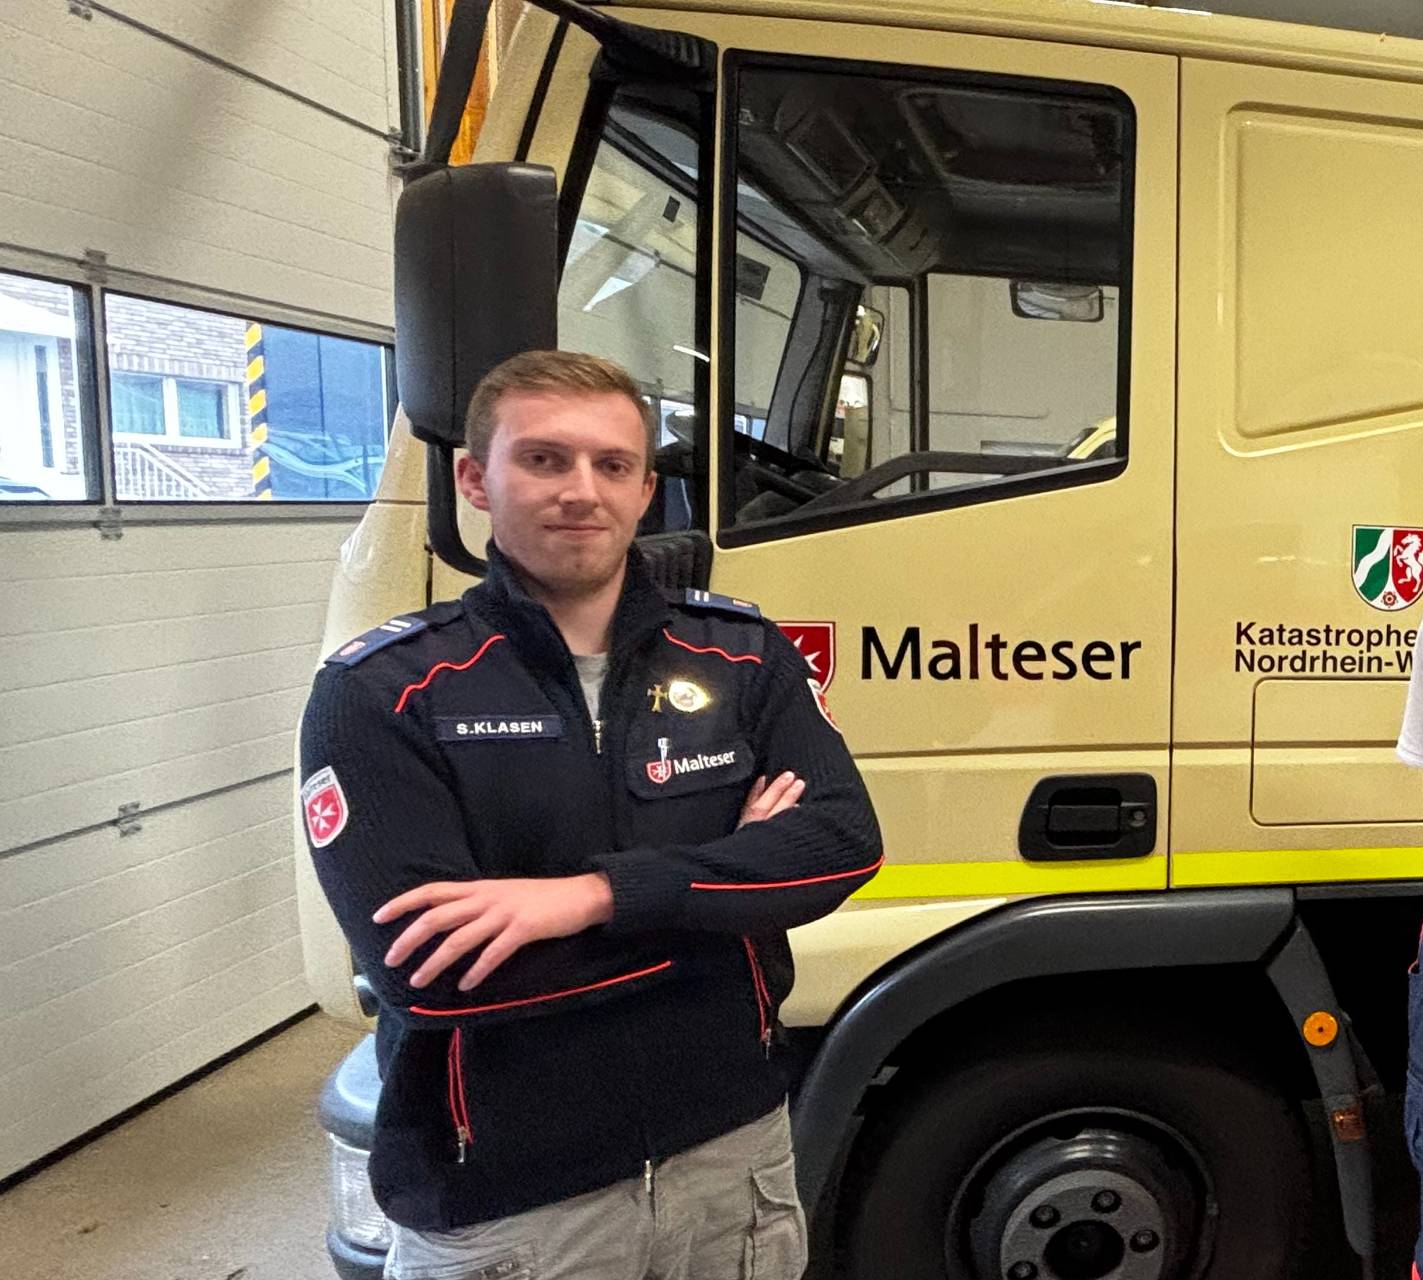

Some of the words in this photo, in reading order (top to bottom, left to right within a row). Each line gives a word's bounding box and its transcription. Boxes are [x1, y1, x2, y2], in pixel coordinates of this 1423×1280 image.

[861, 623, 1142, 681] Malteser
[456, 721, 543, 735] S.KLASEN
[673, 751, 736, 775] Malteser
